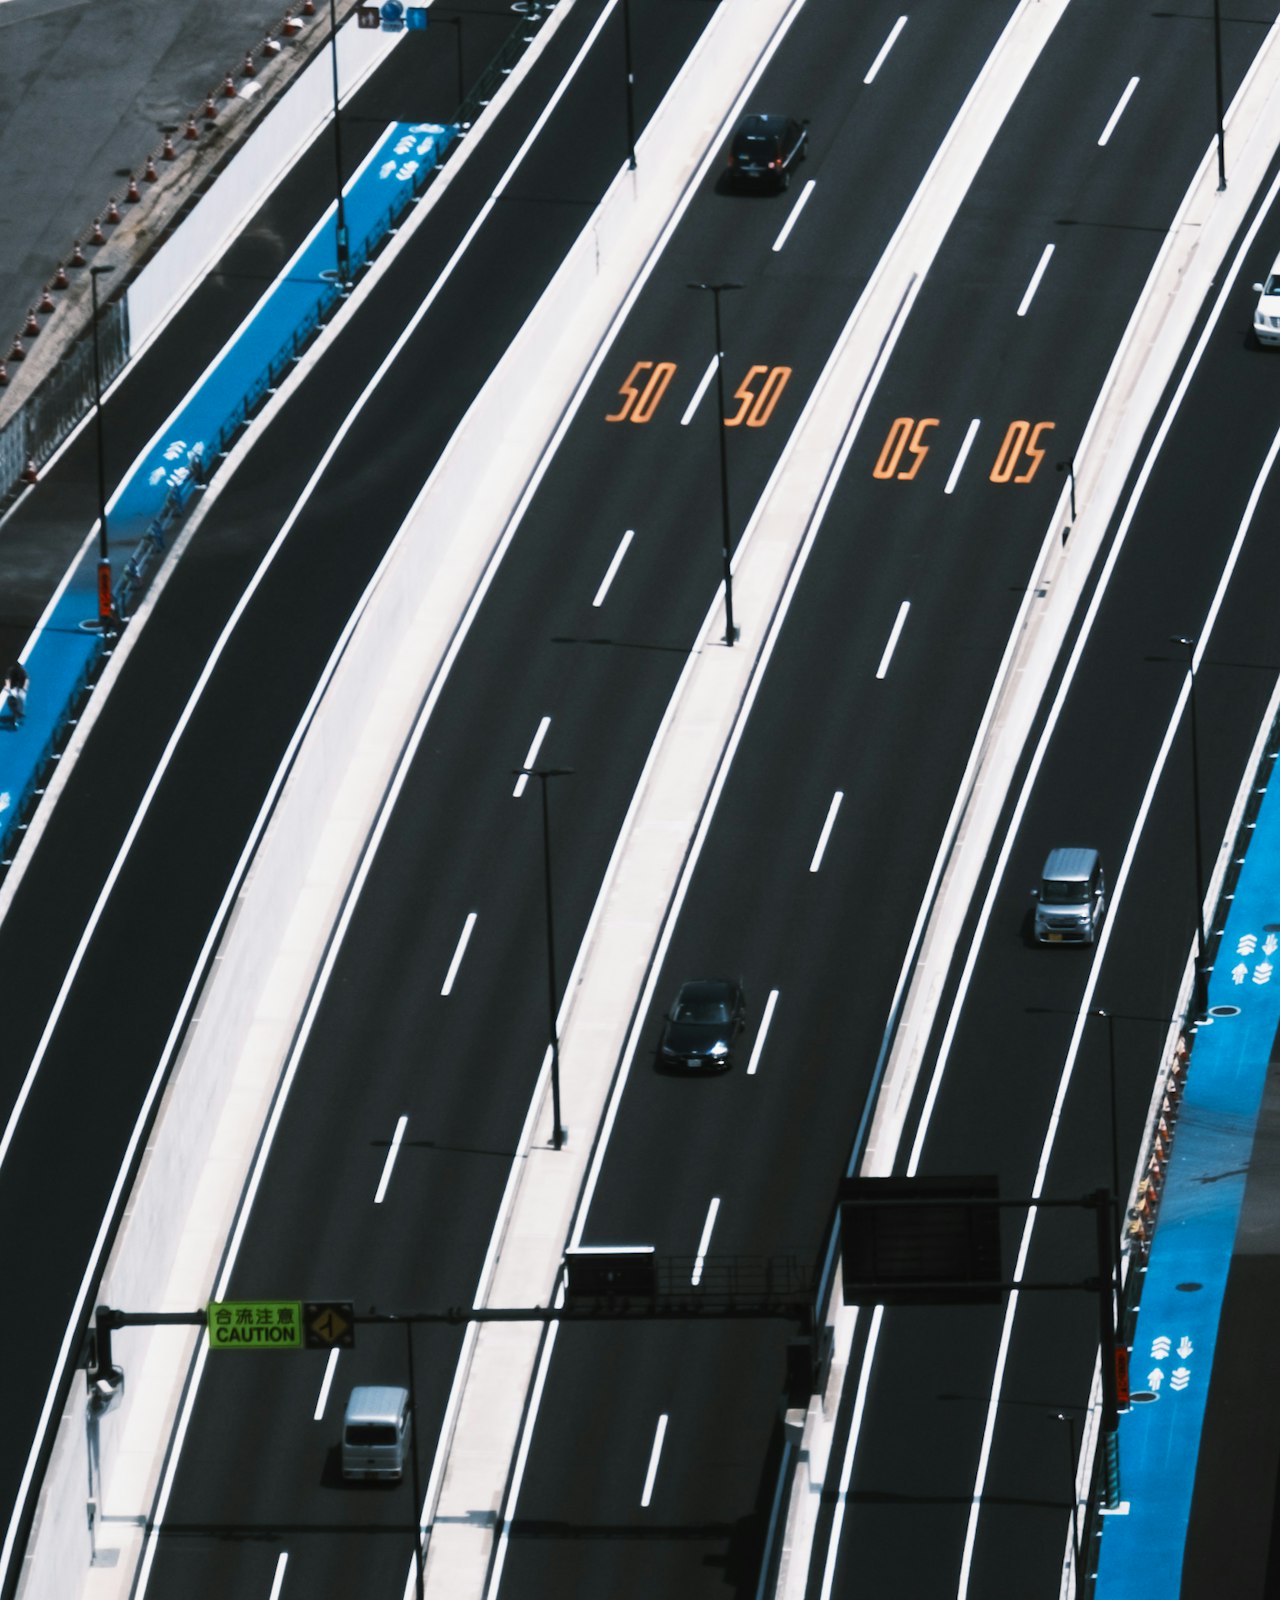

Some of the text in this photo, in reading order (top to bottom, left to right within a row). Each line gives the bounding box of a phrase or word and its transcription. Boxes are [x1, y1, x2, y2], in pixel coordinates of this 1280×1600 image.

[606, 361, 677, 424] 50
[724, 365, 792, 427] 50
[215, 1308, 295, 1326] 合流注意
[216, 1326, 295, 1342] CAUTION
